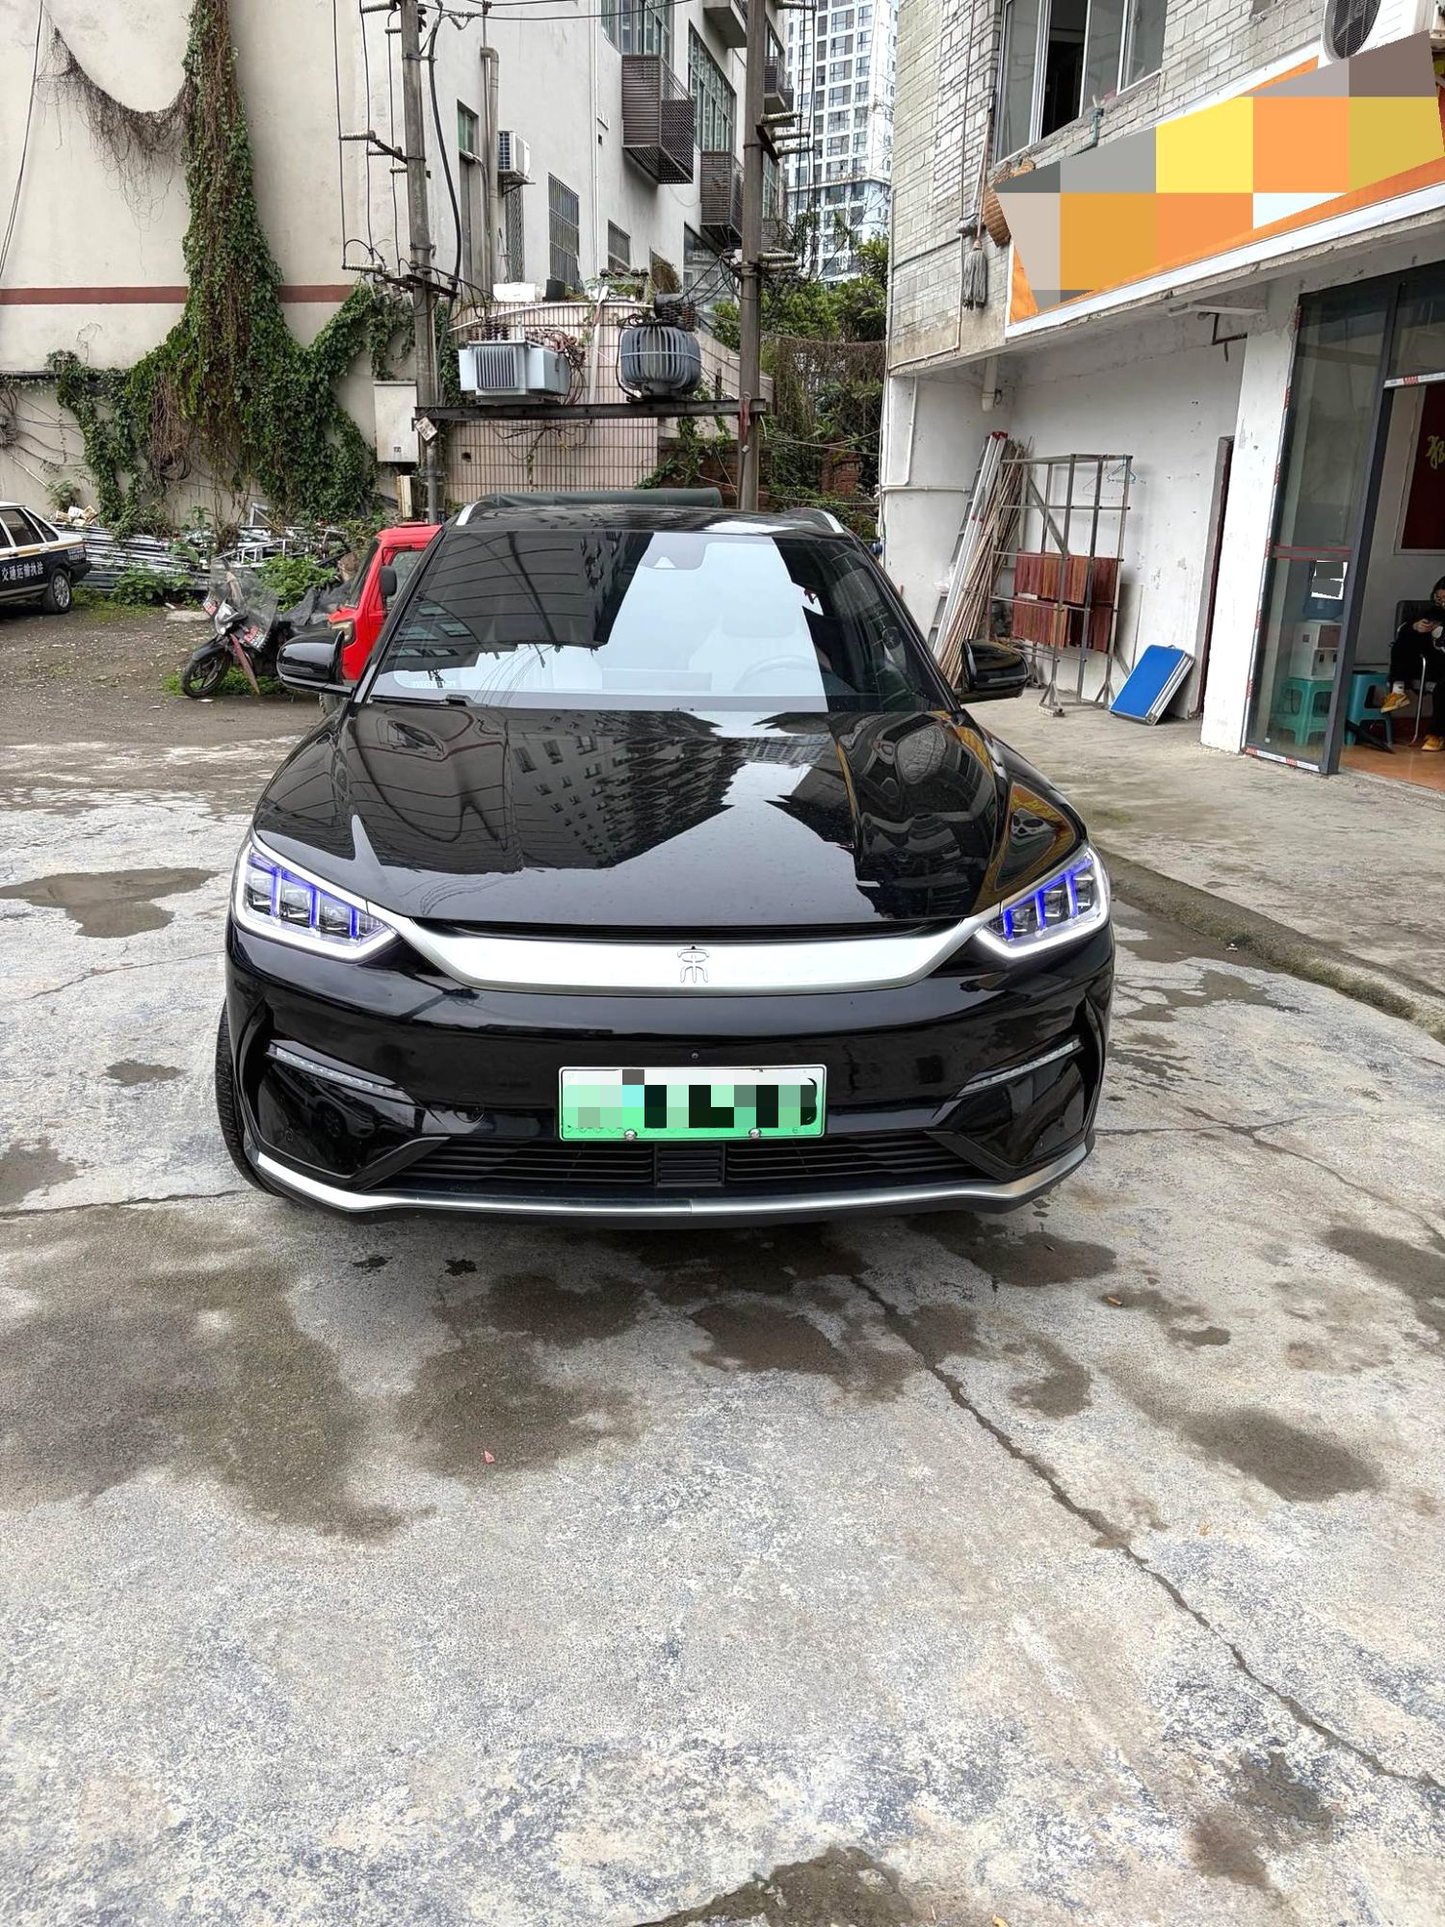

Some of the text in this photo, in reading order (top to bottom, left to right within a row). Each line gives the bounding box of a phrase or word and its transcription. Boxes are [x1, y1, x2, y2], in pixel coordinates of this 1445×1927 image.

[1, 561, 44, 582] 交通运输执法
